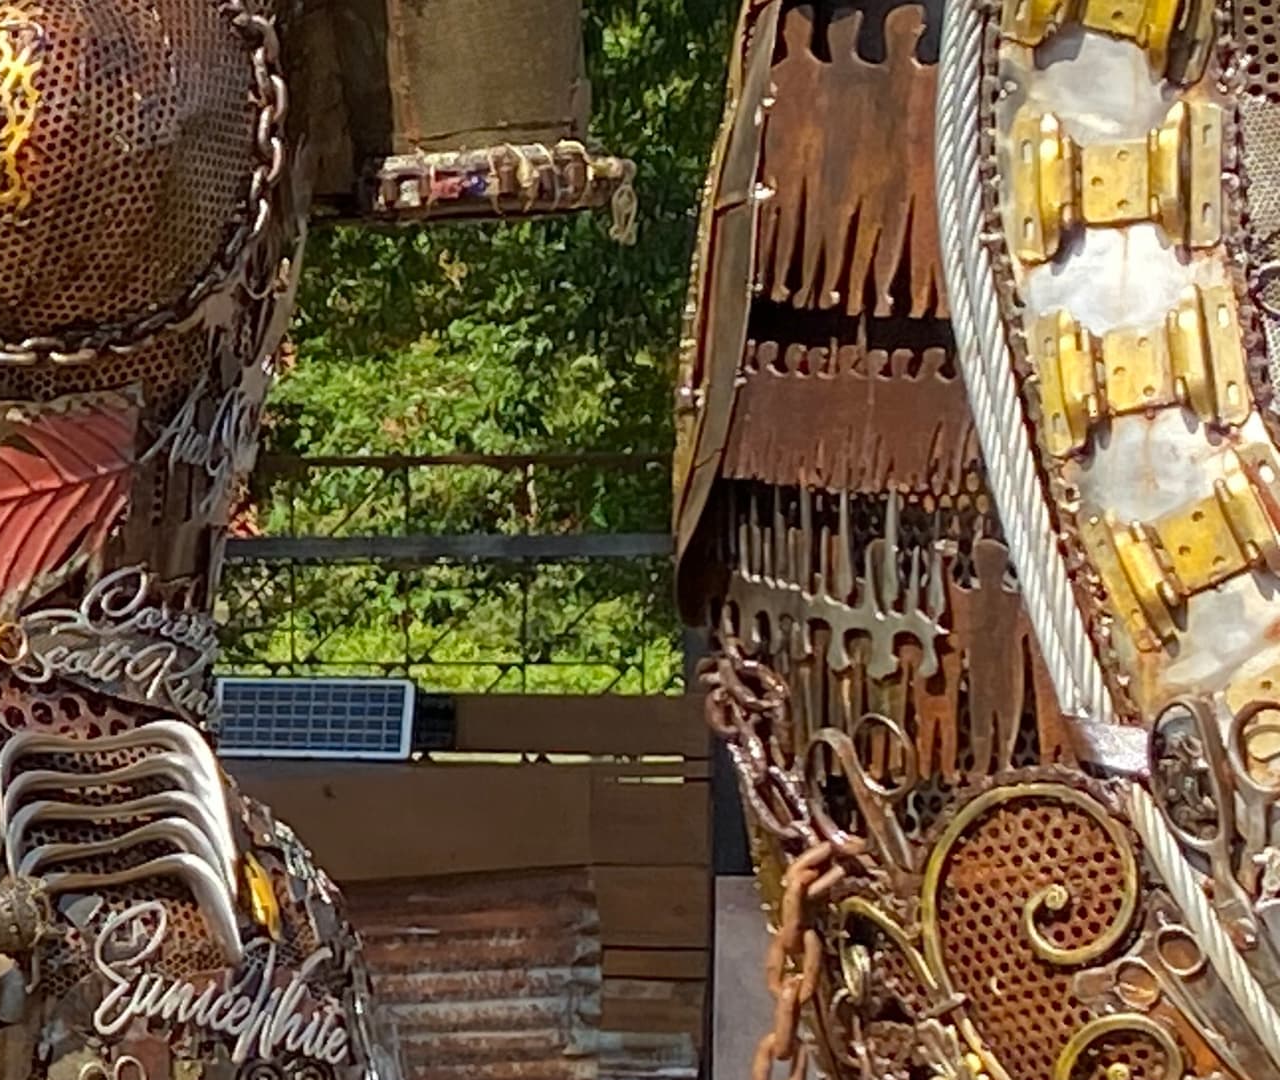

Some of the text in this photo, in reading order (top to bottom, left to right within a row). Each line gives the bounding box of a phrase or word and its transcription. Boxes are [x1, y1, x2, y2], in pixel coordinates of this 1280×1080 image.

[12, 608, 132, 684] Scott
[93, 900, 348, 1065] Eunice White
